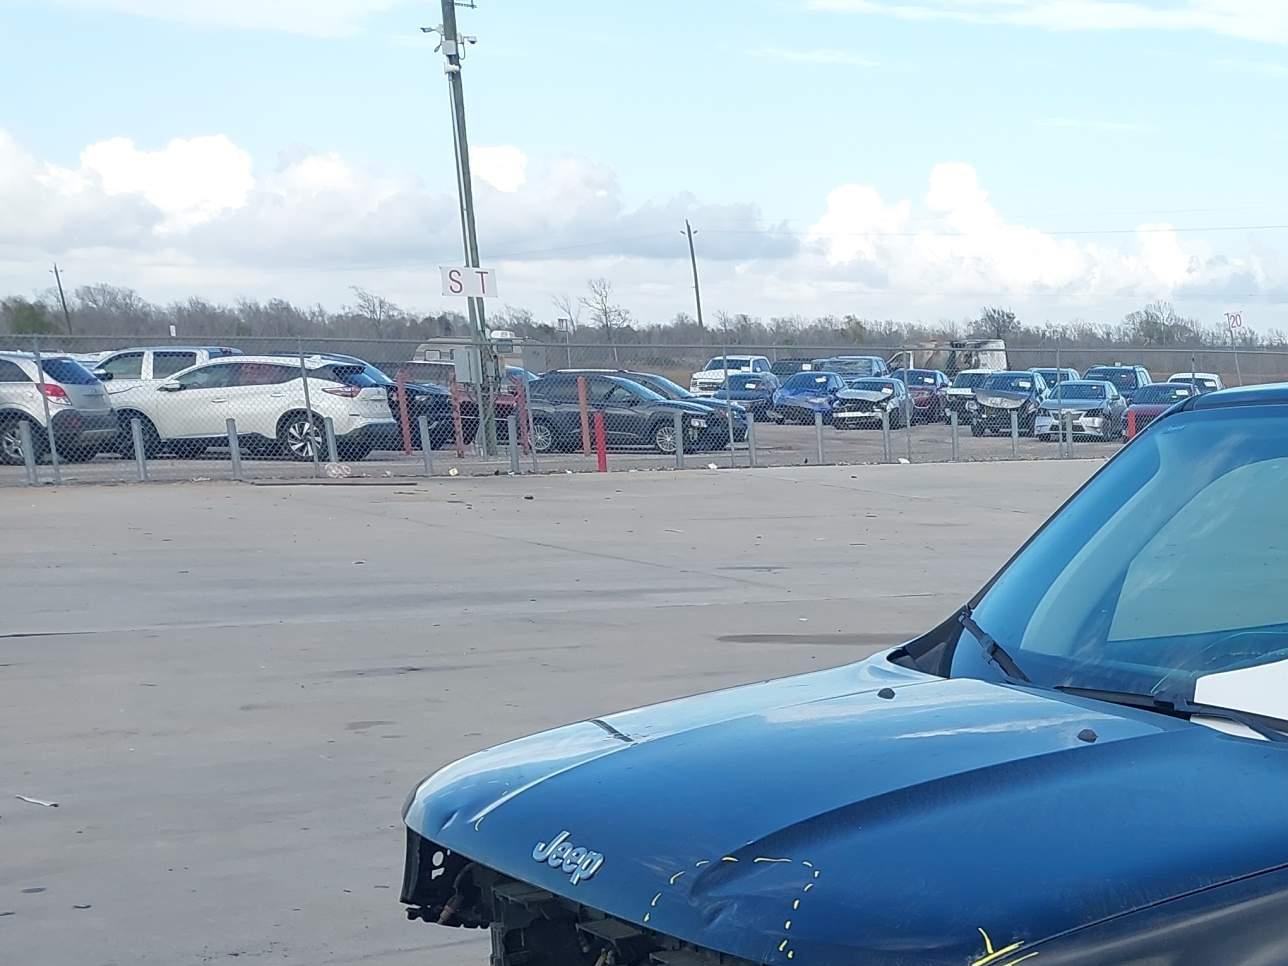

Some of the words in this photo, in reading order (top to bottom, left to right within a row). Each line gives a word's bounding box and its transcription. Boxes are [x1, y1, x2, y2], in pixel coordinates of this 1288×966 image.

[449, 270, 463, 293] S
[475, 271, 488, 294] T
[1230, 314, 1242, 328] 20
[533, 831, 604, 885] Jeep
